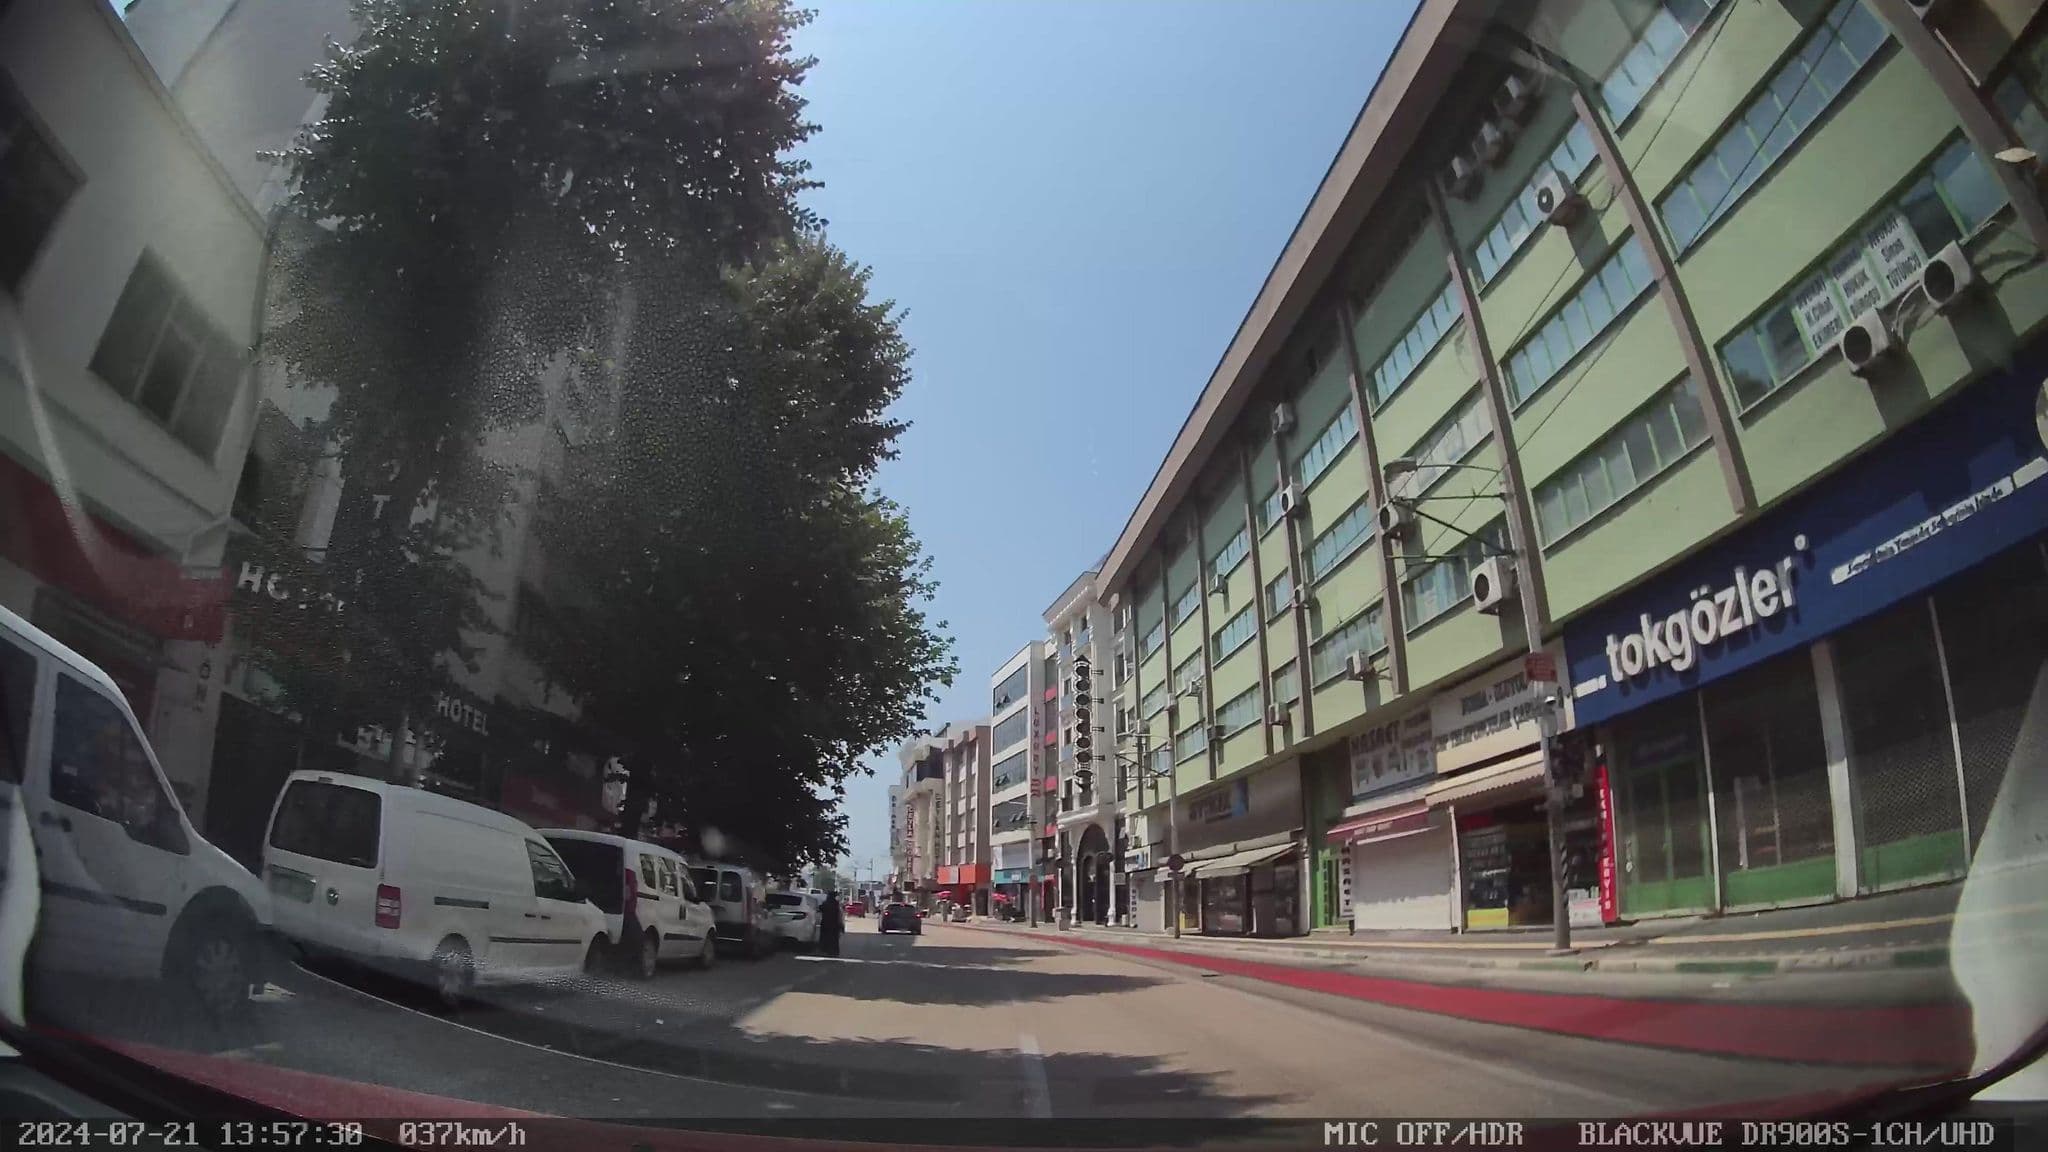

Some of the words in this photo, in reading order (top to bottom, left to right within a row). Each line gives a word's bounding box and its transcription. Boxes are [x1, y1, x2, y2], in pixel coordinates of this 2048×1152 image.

[1605, 555, 1794, 672] tokgözler
[437, 694, 489, 737] HOTEL
[1032, 706, 1040, 775] LUXURY
